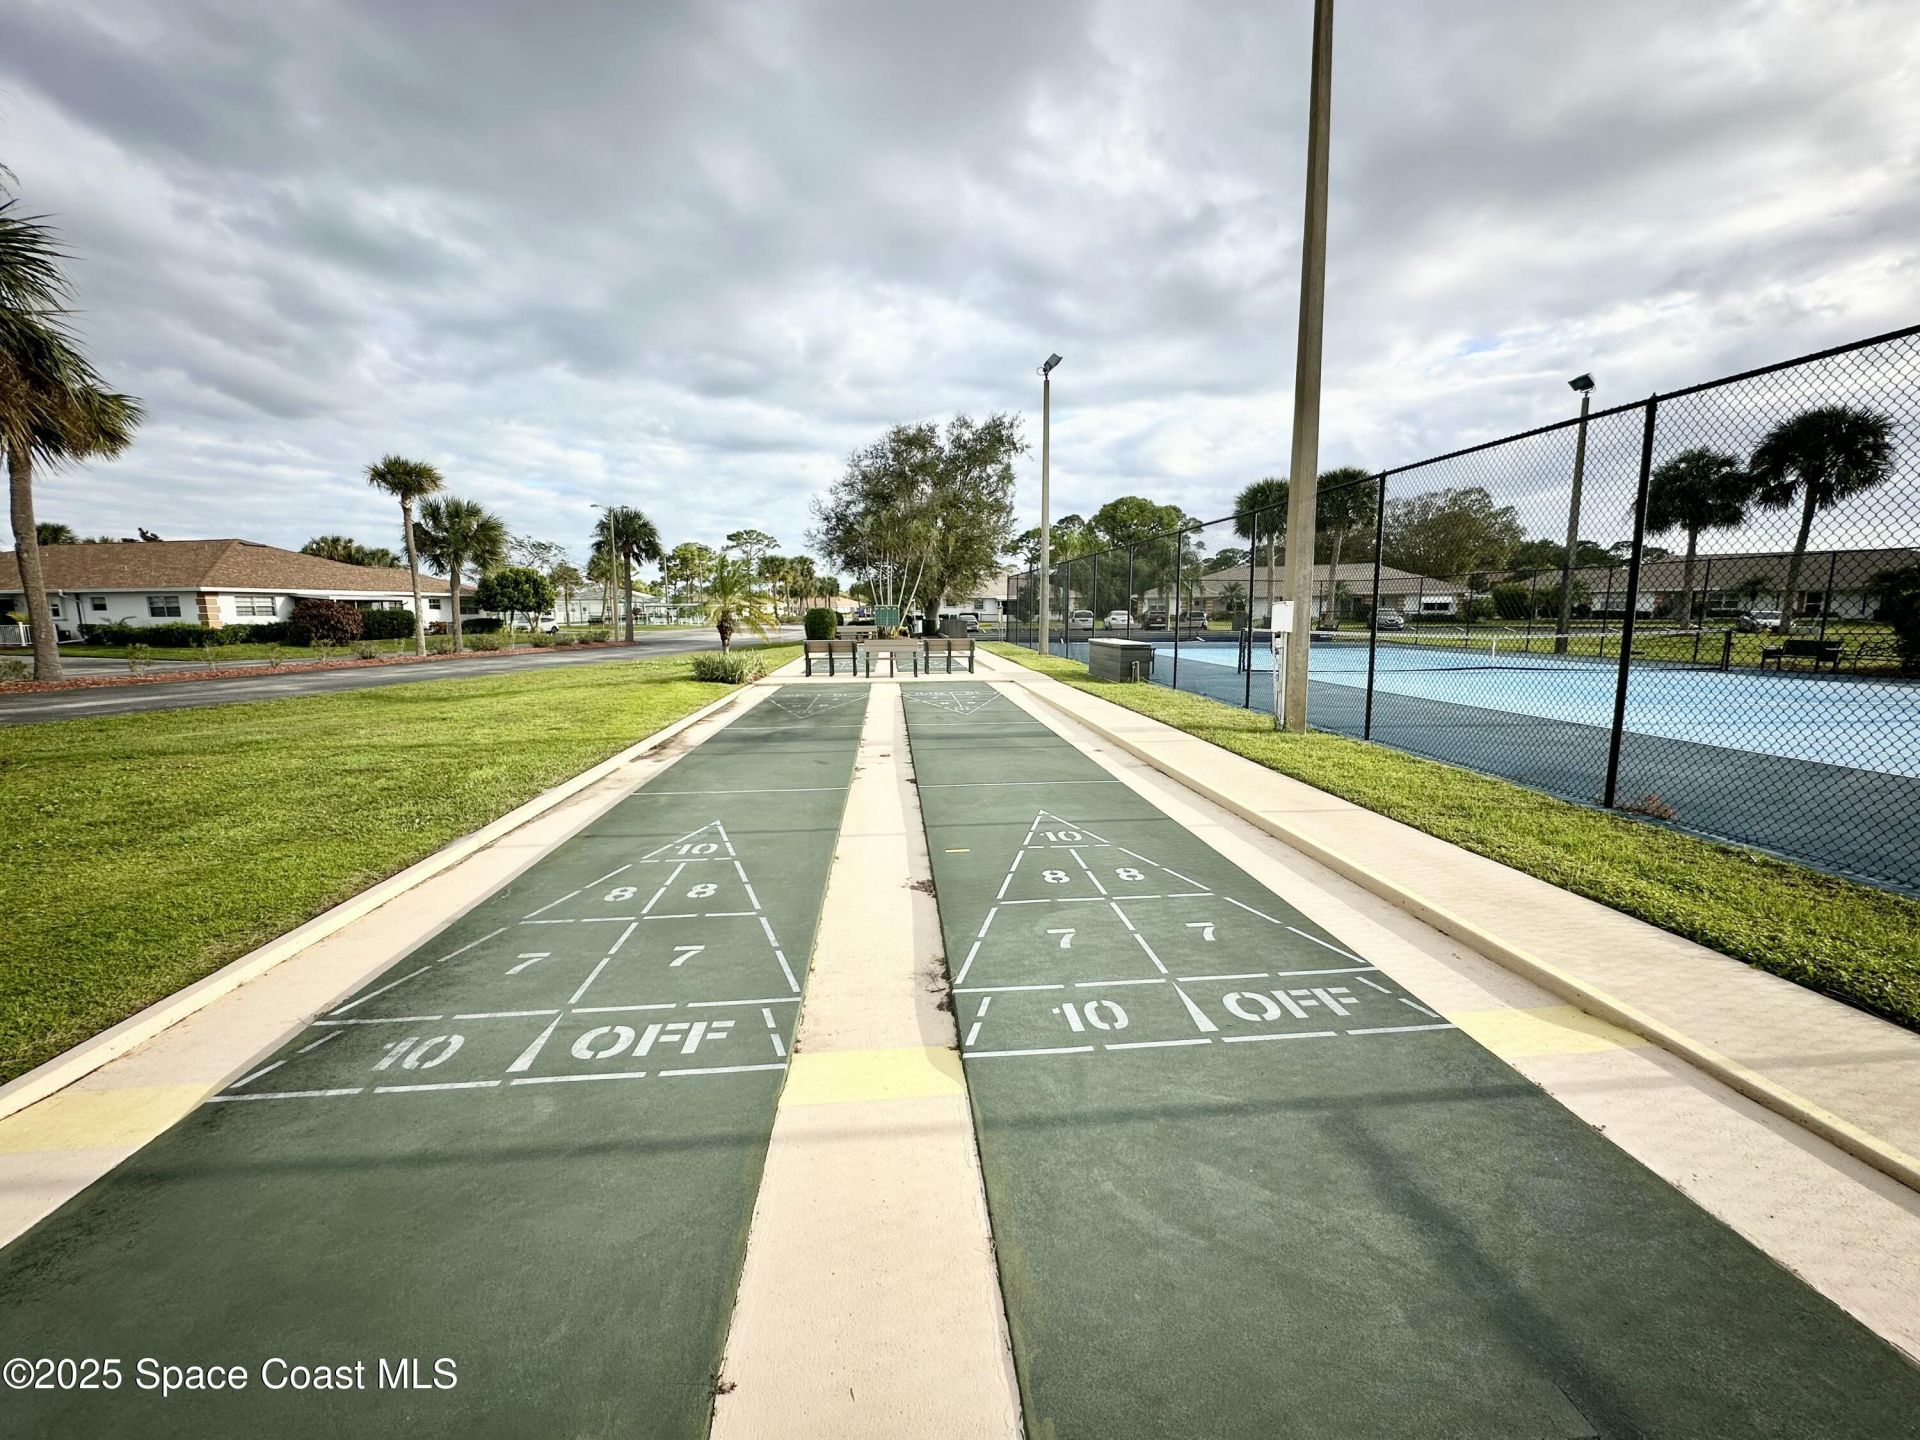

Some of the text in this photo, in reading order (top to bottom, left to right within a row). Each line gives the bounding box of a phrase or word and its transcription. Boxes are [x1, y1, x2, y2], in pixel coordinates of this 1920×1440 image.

[1040, 831, 1083, 842] 10
[675, 842, 718, 855] 10
[1041, 869, 1071, 884] 8
[1115, 867, 1145, 881] 8
[604, 886, 638, 902] 8
[686, 883, 718, 898] 8
[1046, 927, 1077, 949] 7
[1185, 921, 1216, 941] 7
[505, 952, 552, 975] 7
[669, 944, 706, 967] 7
[1051, 987, 1360, 1032] 10 OFF
[372, 1020, 736, 1071] 10 OFF
